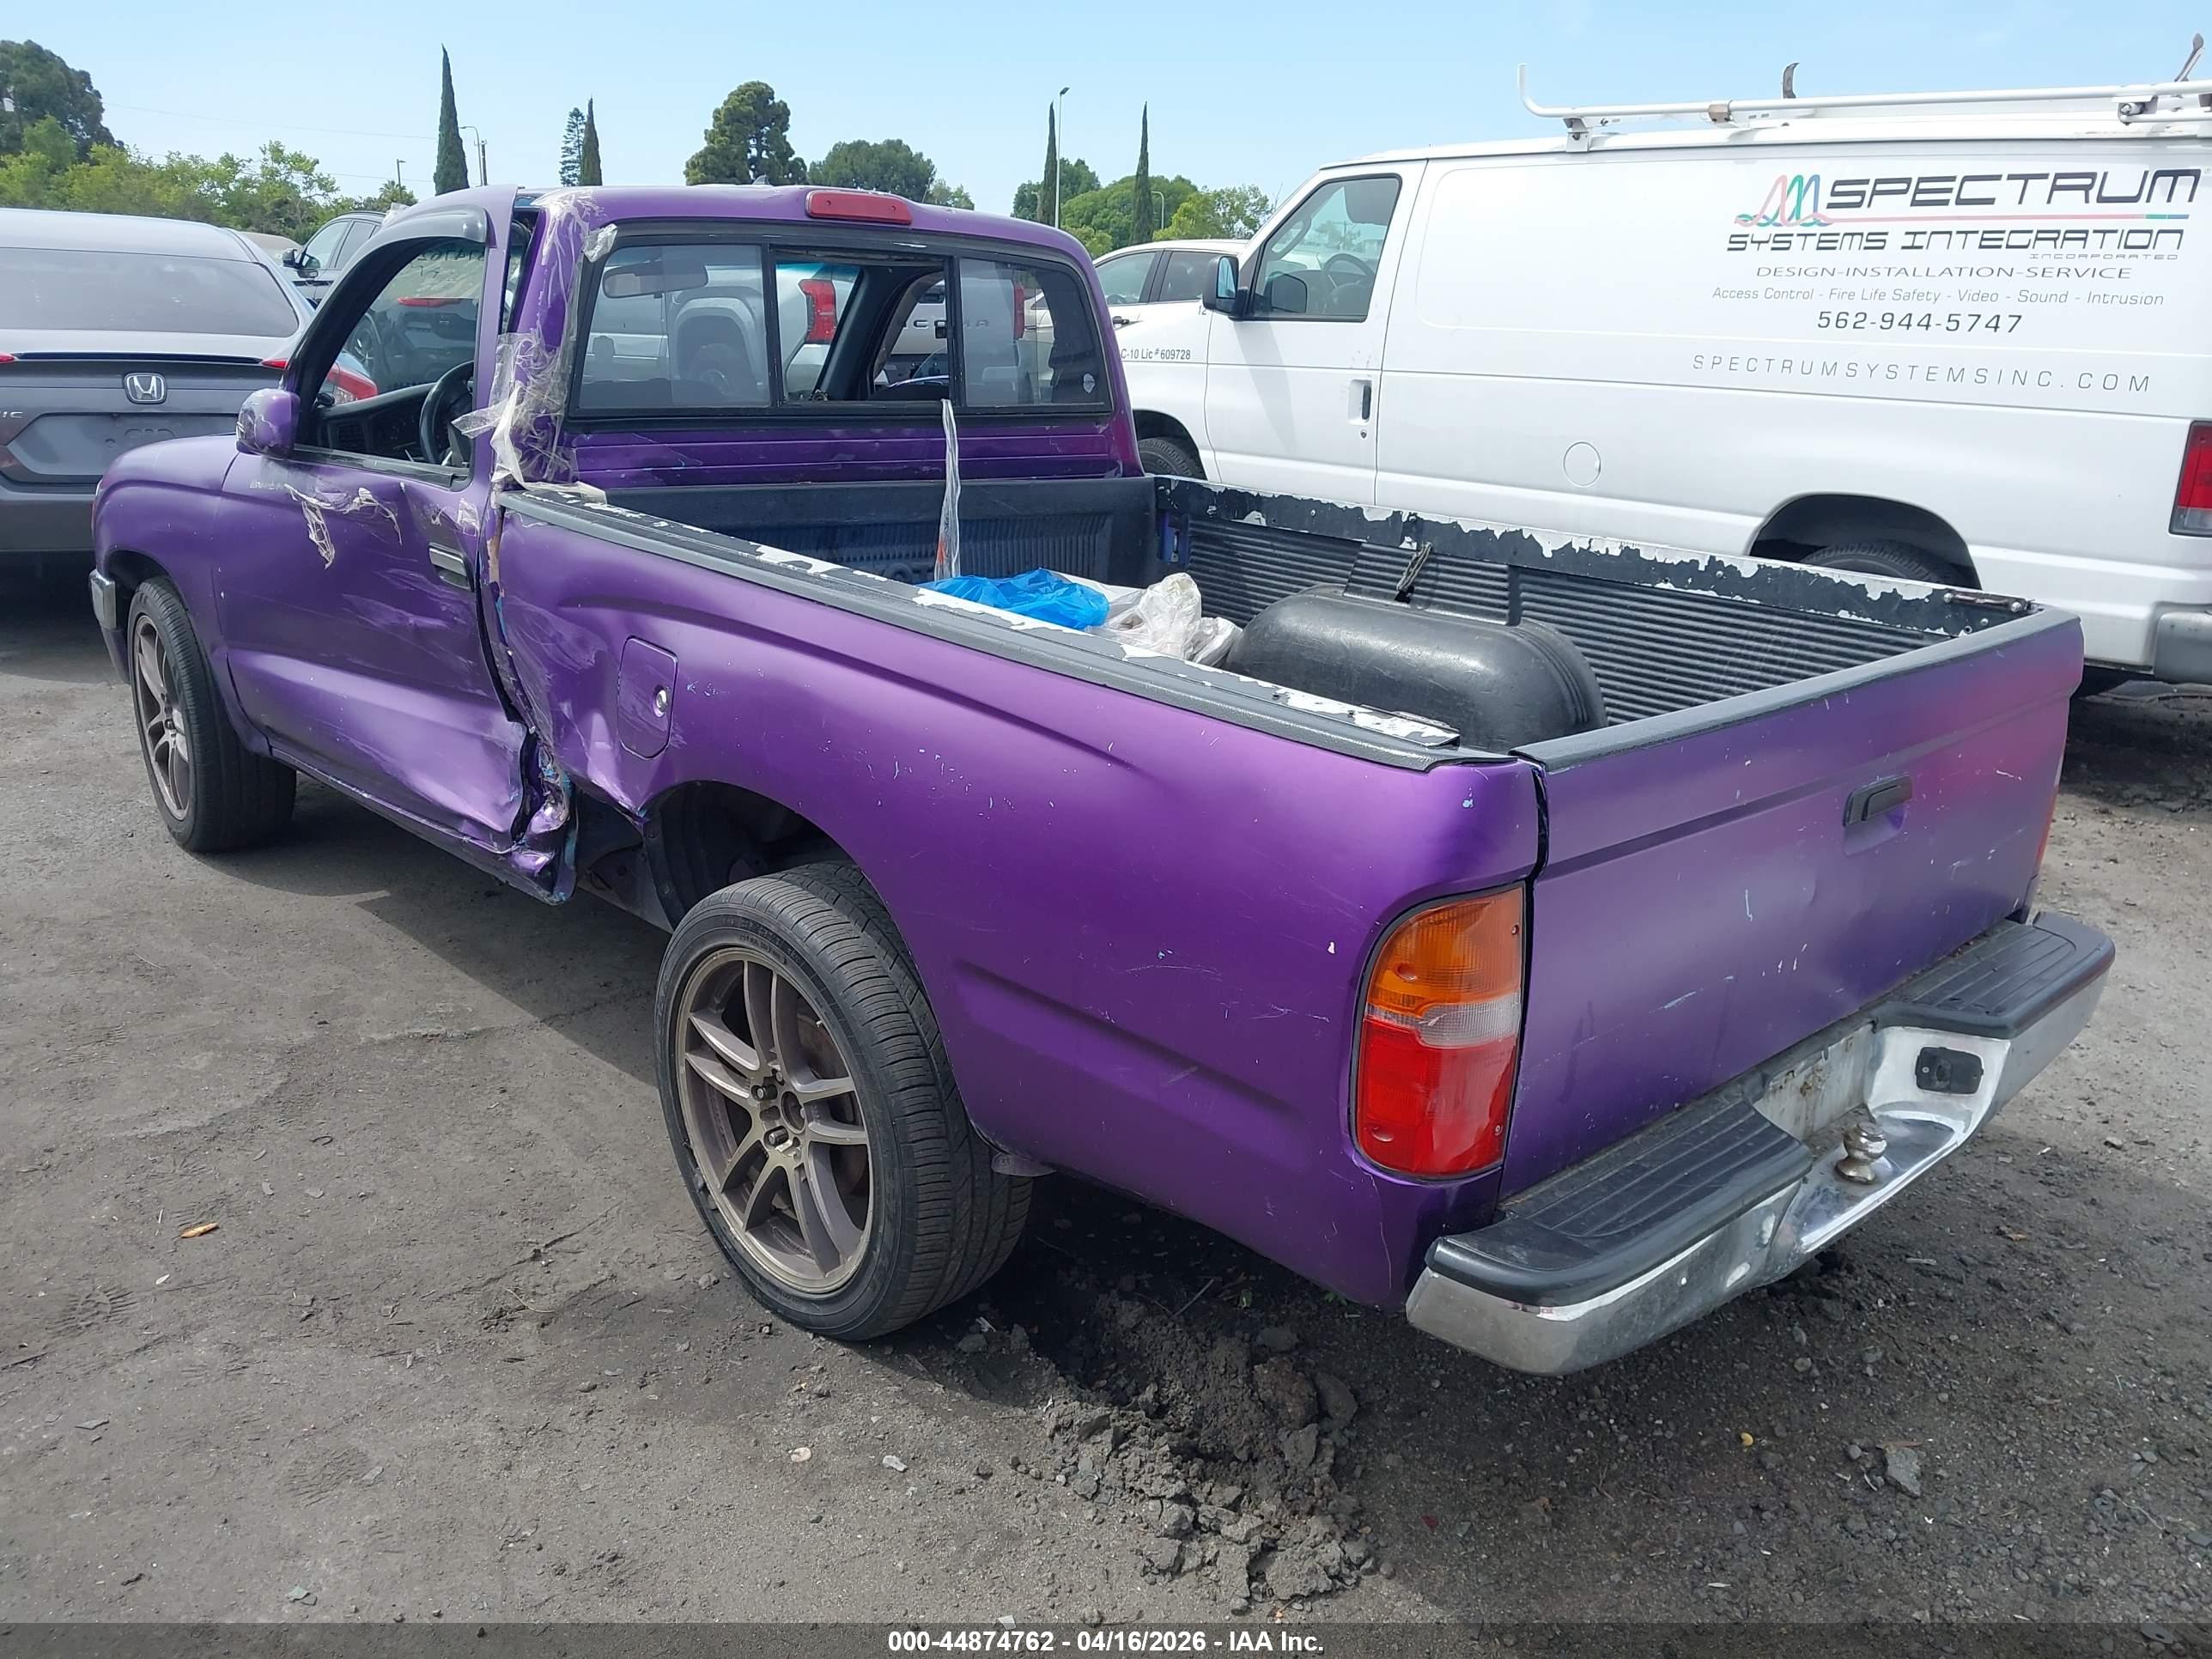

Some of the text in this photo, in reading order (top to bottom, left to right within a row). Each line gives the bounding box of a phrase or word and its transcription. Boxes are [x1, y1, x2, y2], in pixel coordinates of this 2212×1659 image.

[1826, 168, 2202, 209] SPECTRUM
[1727, 229, 2184, 251] SYSTEMS INTEGRATION
[1712, 286, 1759, 300] Access
[1764, 287, 1814, 301] Control
[1828, 288, 1856, 301] Fire
[1861, 288, 1887, 301] Life
[1892, 289, 1941, 304] Safety
[1958, 289, 1999, 302] Video
[2018, 289, 2069, 303] Sound
[2087, 291, 2164, 305] Intrusion
[1817, 311, 2022, 333] 562-944-5747
[1121, 349, 1139, 359] C-10
[1141, 349, 1153, 359] Lic
[1692, 355, 2149, 392] SPECTRUMSYSTEMSINC.COM
